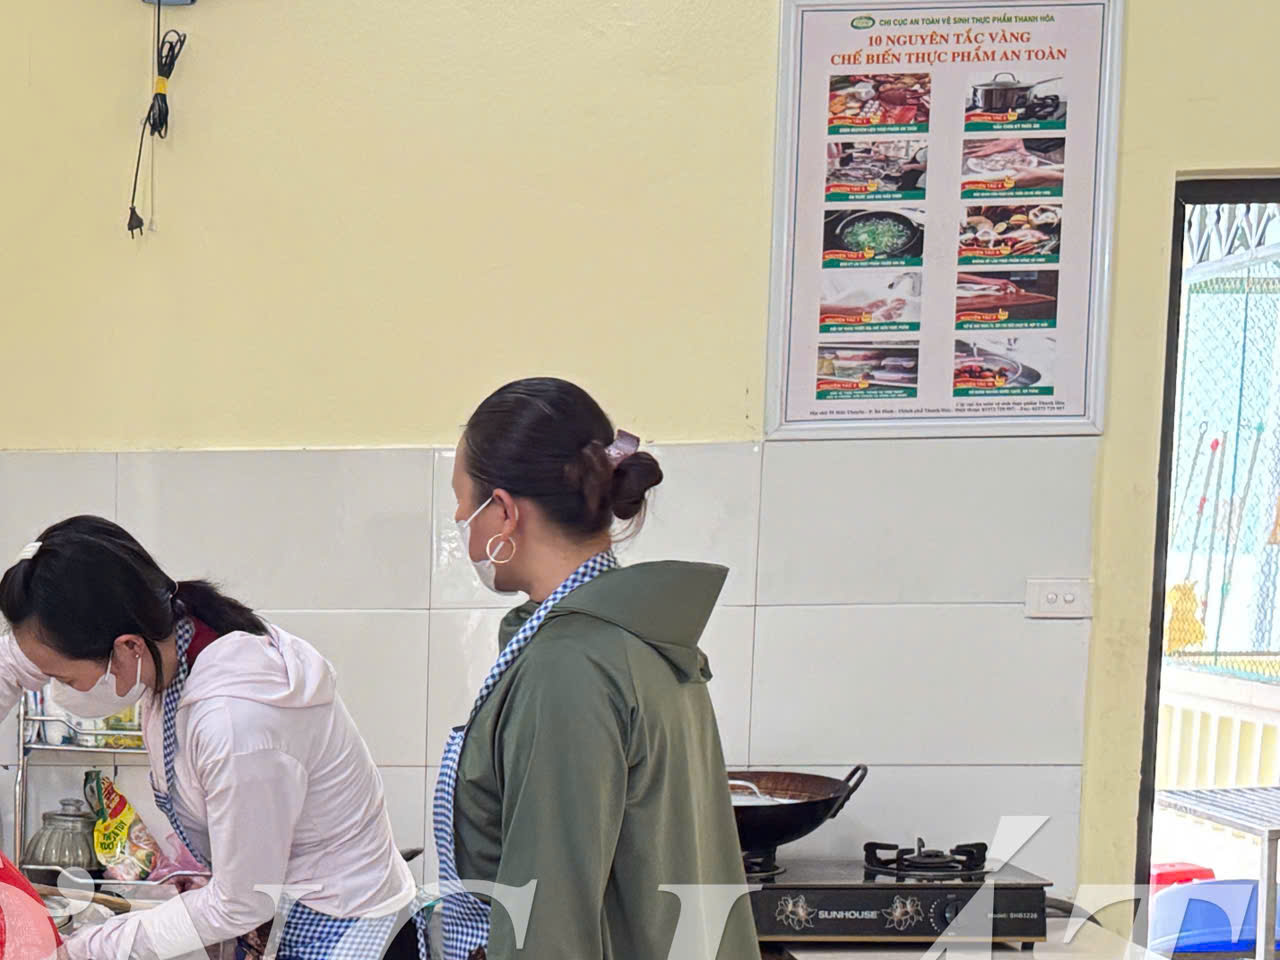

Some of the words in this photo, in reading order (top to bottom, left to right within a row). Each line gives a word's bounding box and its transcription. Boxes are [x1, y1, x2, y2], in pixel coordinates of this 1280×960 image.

[868, 35, 882, 47] 10
[885, 30, 949, 47] NGUYÊN
[953, 27, 985, 45] TẮC
[988, 28, 1031, 44] VÀNG
[830, 47, 863, 66] CHẾ
[865, 48, 902, 65] BIẾN
[905, 49, 948, 67] THỰC
[951, 45, 996, 63] PHẨM
[999, 49, 1021, 62] AN
[1024, 45, 1067, 62] TOÀN
[818, 910, 877, 919] SUNHOUSE
